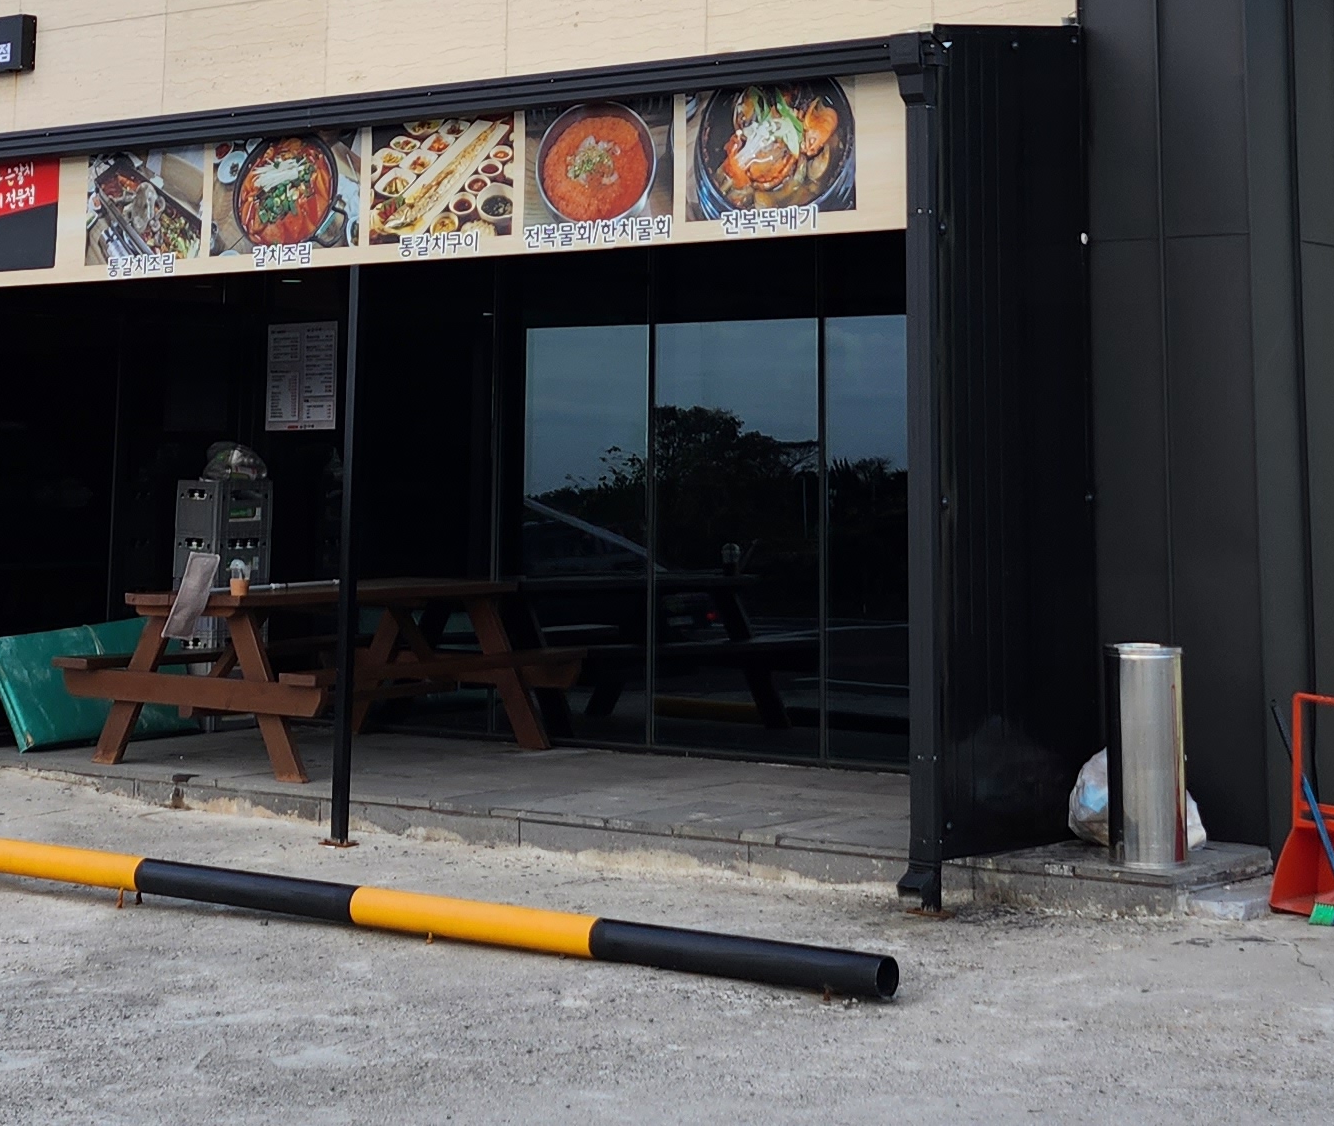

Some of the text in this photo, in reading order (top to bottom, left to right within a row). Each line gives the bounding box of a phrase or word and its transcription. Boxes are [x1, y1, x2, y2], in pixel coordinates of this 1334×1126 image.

[5, 161, 35, 187] 은갈치
[5, 184, 36, 210] 전문점
[523, 215, 672, 249] 전복물회/한치물회
[720, 204, 818, 235] 전복뚝배기
[253, 241, 312, 268] 갈치조림
[398, 230, 480, 257] 통갈치구이
[107, 252, 175, 278] 통갈치조림
